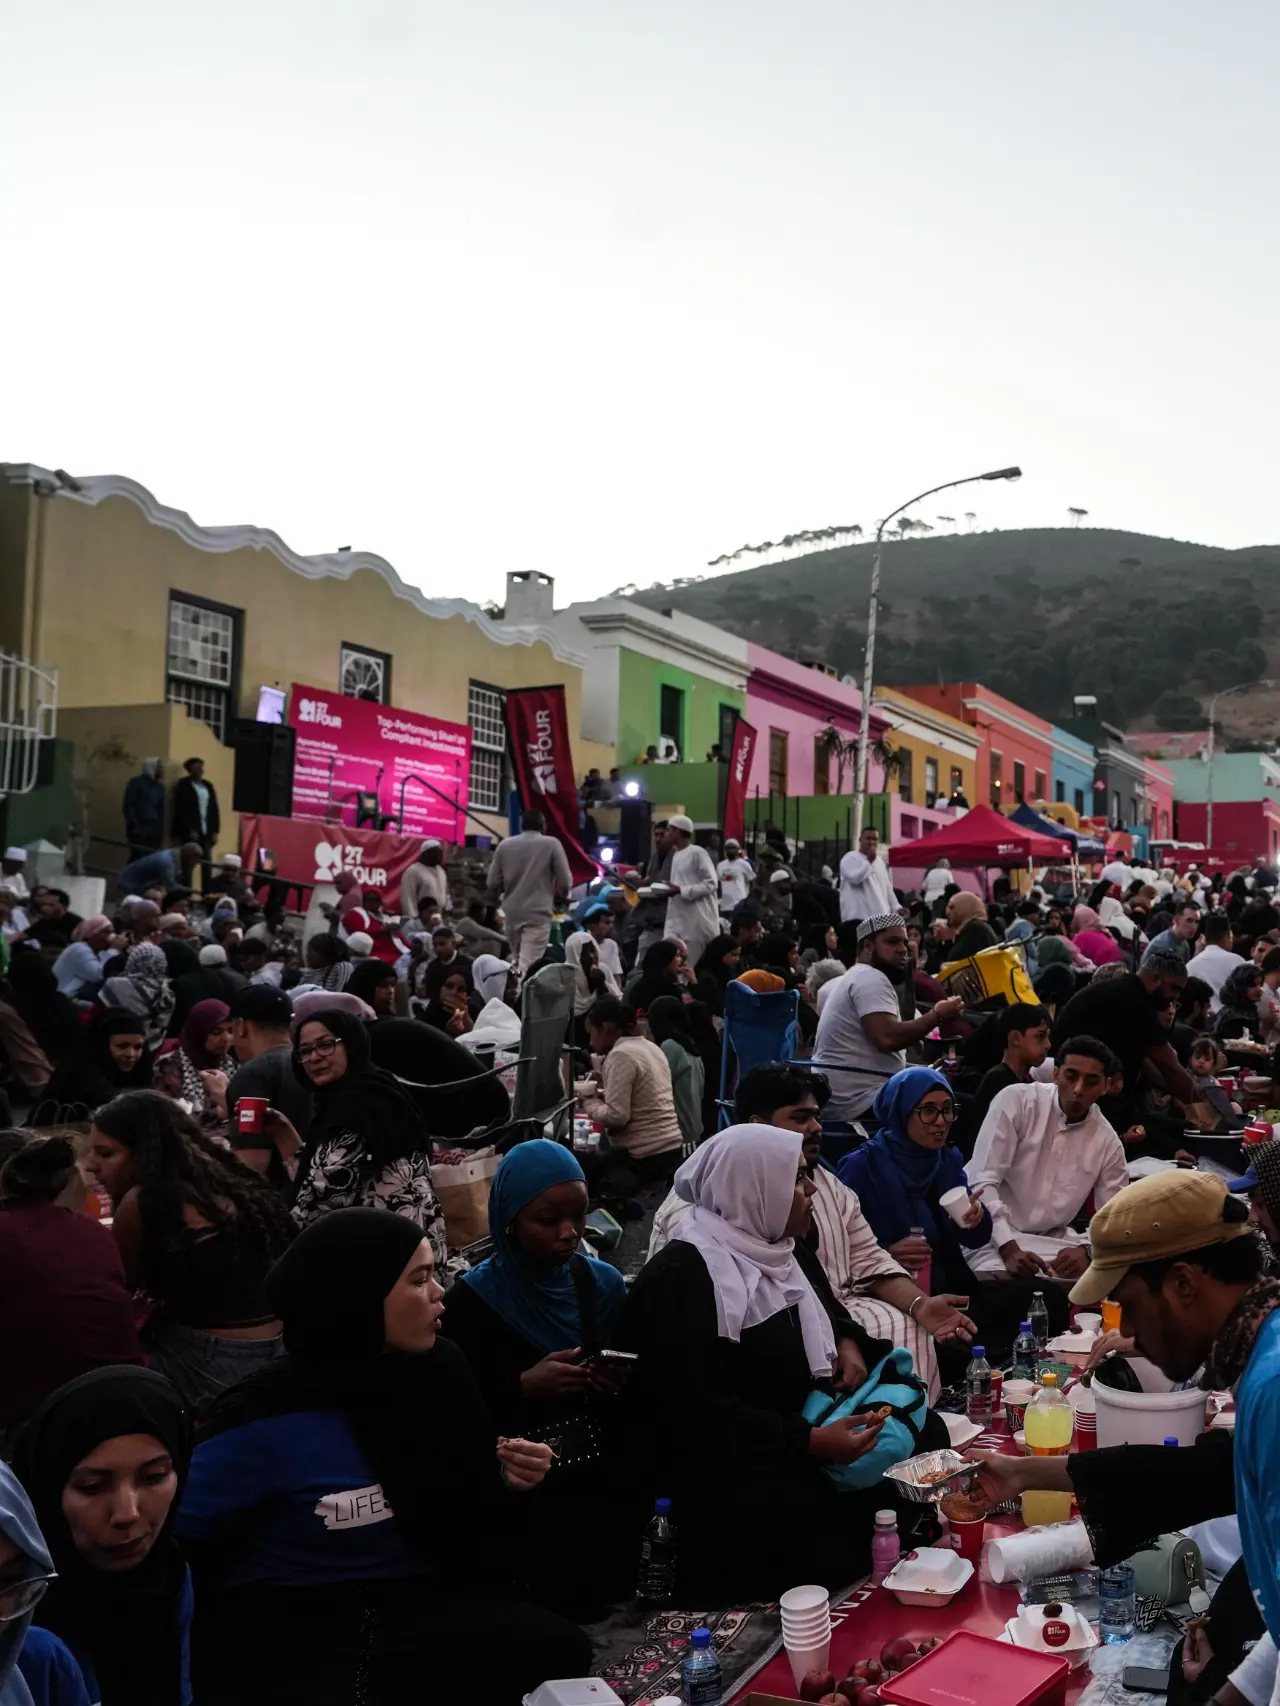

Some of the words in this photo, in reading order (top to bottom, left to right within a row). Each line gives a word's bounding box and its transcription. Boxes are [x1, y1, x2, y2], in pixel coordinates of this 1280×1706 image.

[316, 711, 342, 729] FOUR
[536, 709, 554, 763] FOUR
[345, 845, 363, 864] 27
